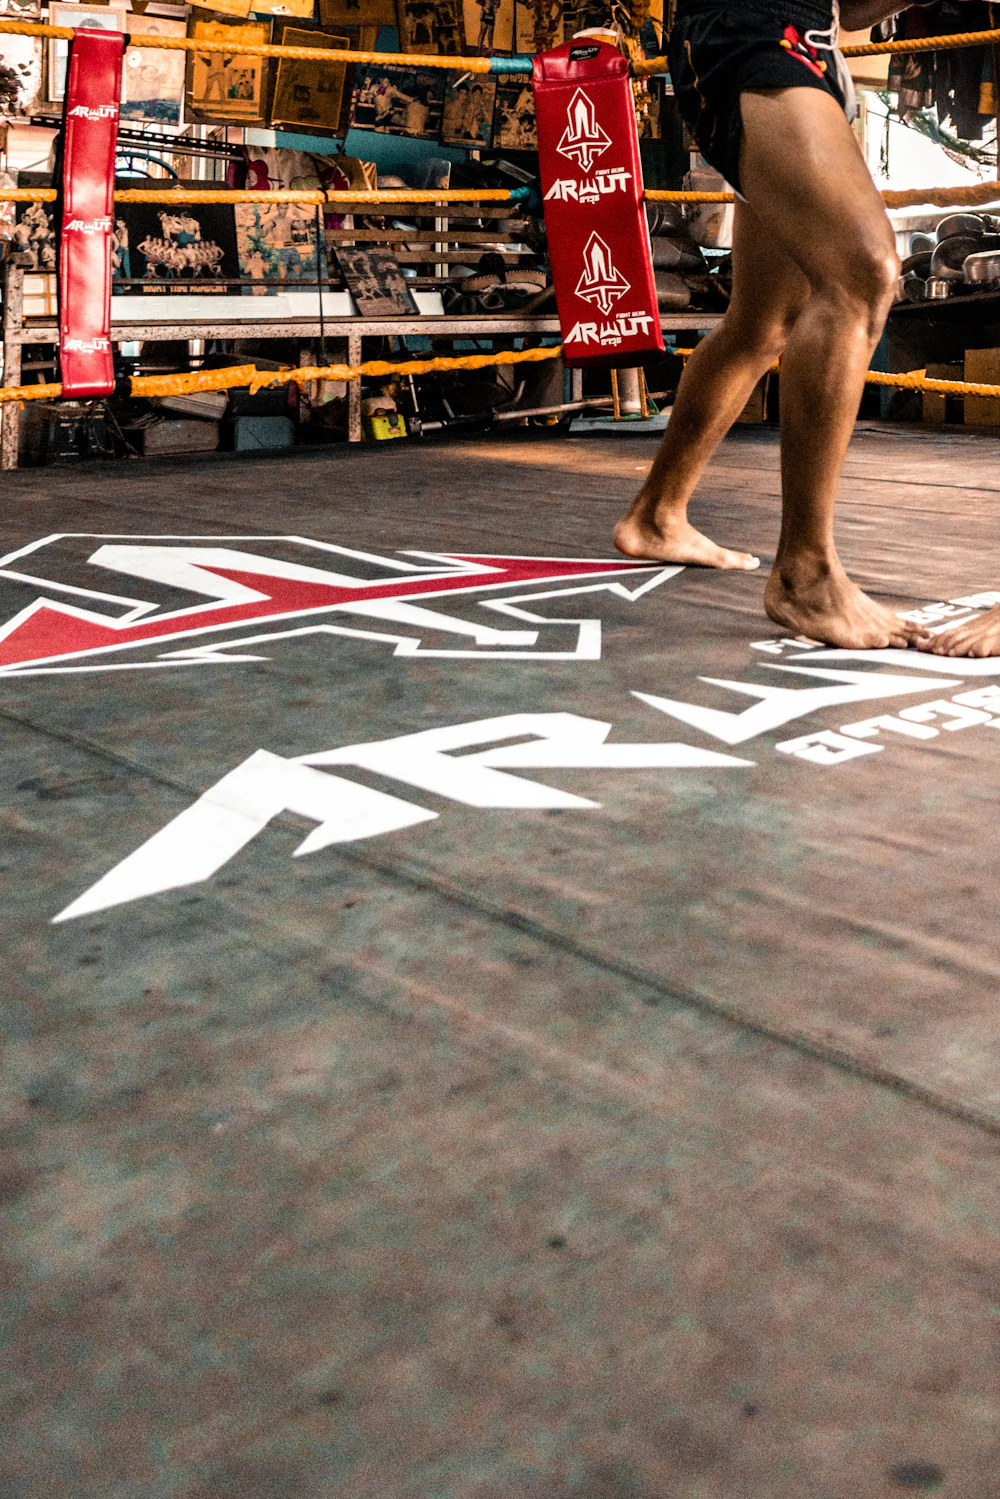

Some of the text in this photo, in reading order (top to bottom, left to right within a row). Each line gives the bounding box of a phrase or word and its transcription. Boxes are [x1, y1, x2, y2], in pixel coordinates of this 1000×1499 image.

[68, 105, 118, 118] ARWUT
[543, 172, 632, 202] ARWUT
[64, 219, 112, 231] ARWUT
[563, 316, 654, 345] ARWUT
[63, 339, 110, 351] ARWUT
